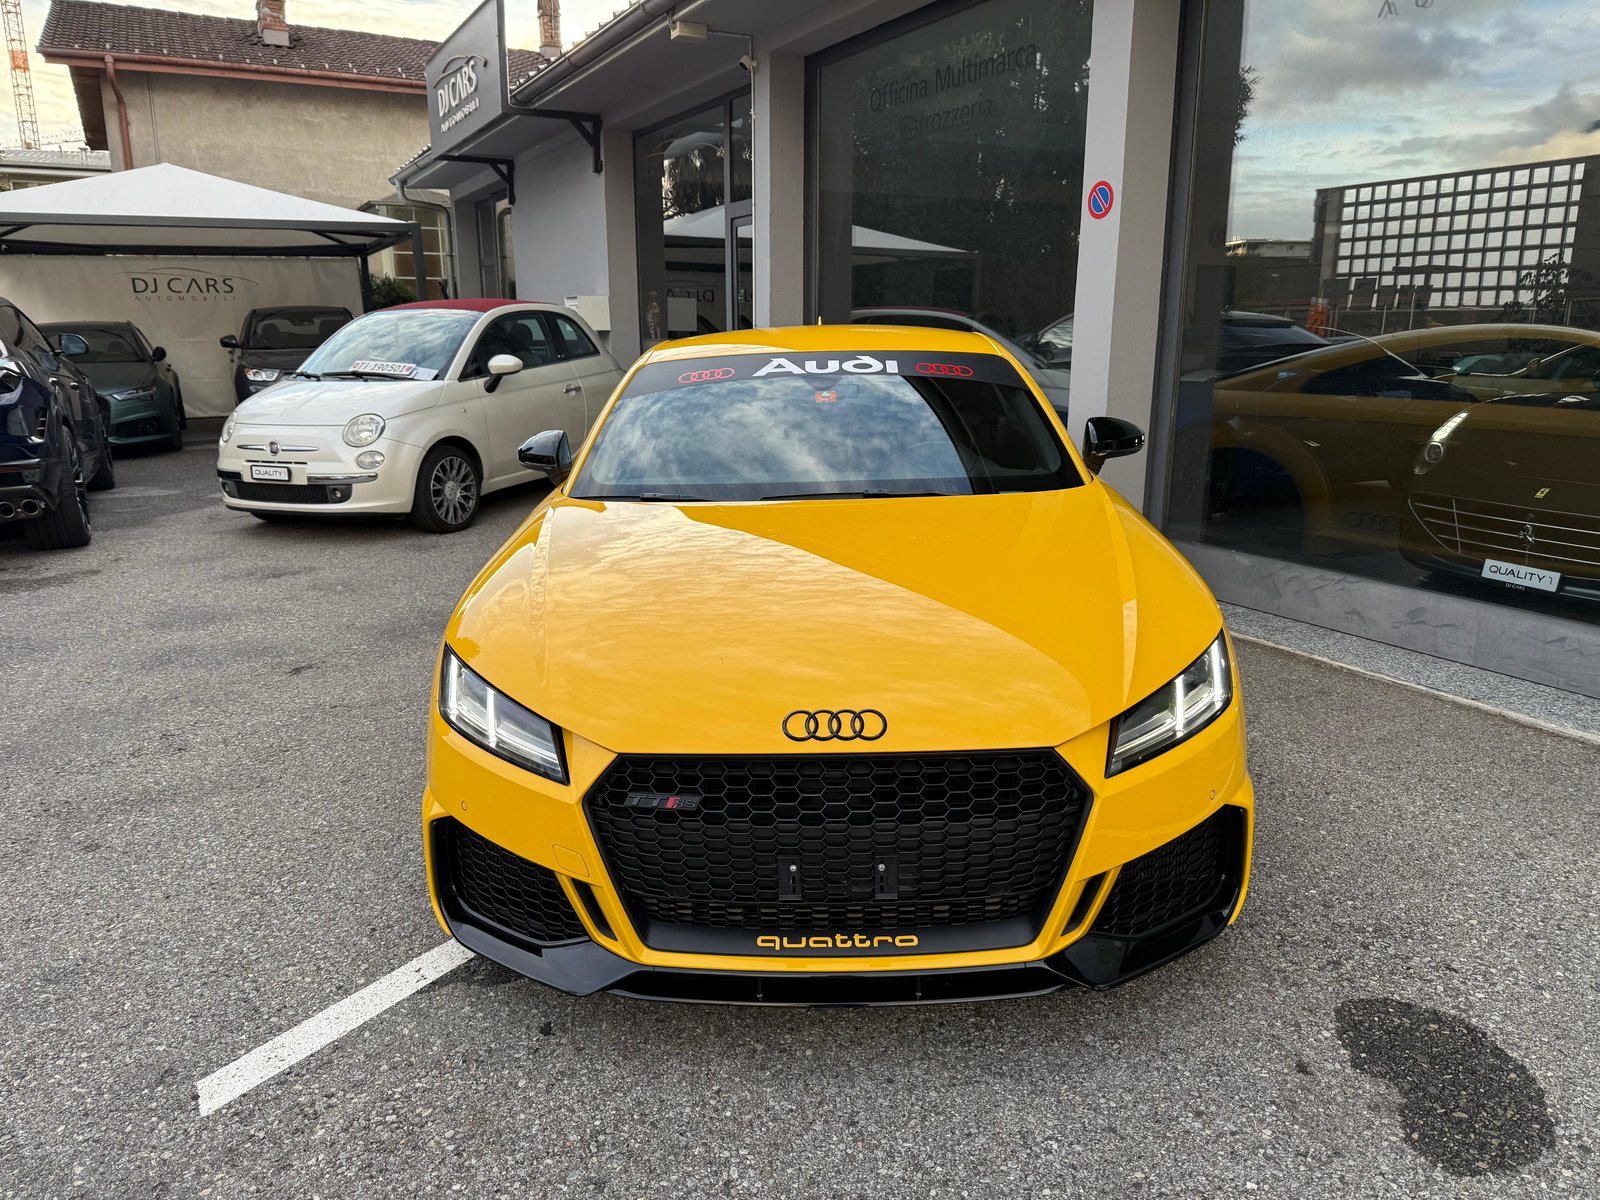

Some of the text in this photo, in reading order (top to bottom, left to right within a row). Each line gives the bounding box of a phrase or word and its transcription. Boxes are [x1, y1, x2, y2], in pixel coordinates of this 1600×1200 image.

[449, 60, 478, 107] CARS
[870, 42, 1037, 113] Officina Multimarca
[131, 277, 235, 294] DJ CARS
[752, 355, 900, 377] Audi
[254, 469, 283, 477] QUALITY
[1488, 564, 1546, 583] QUALITY
[756, 933, 919, 950] quattro
